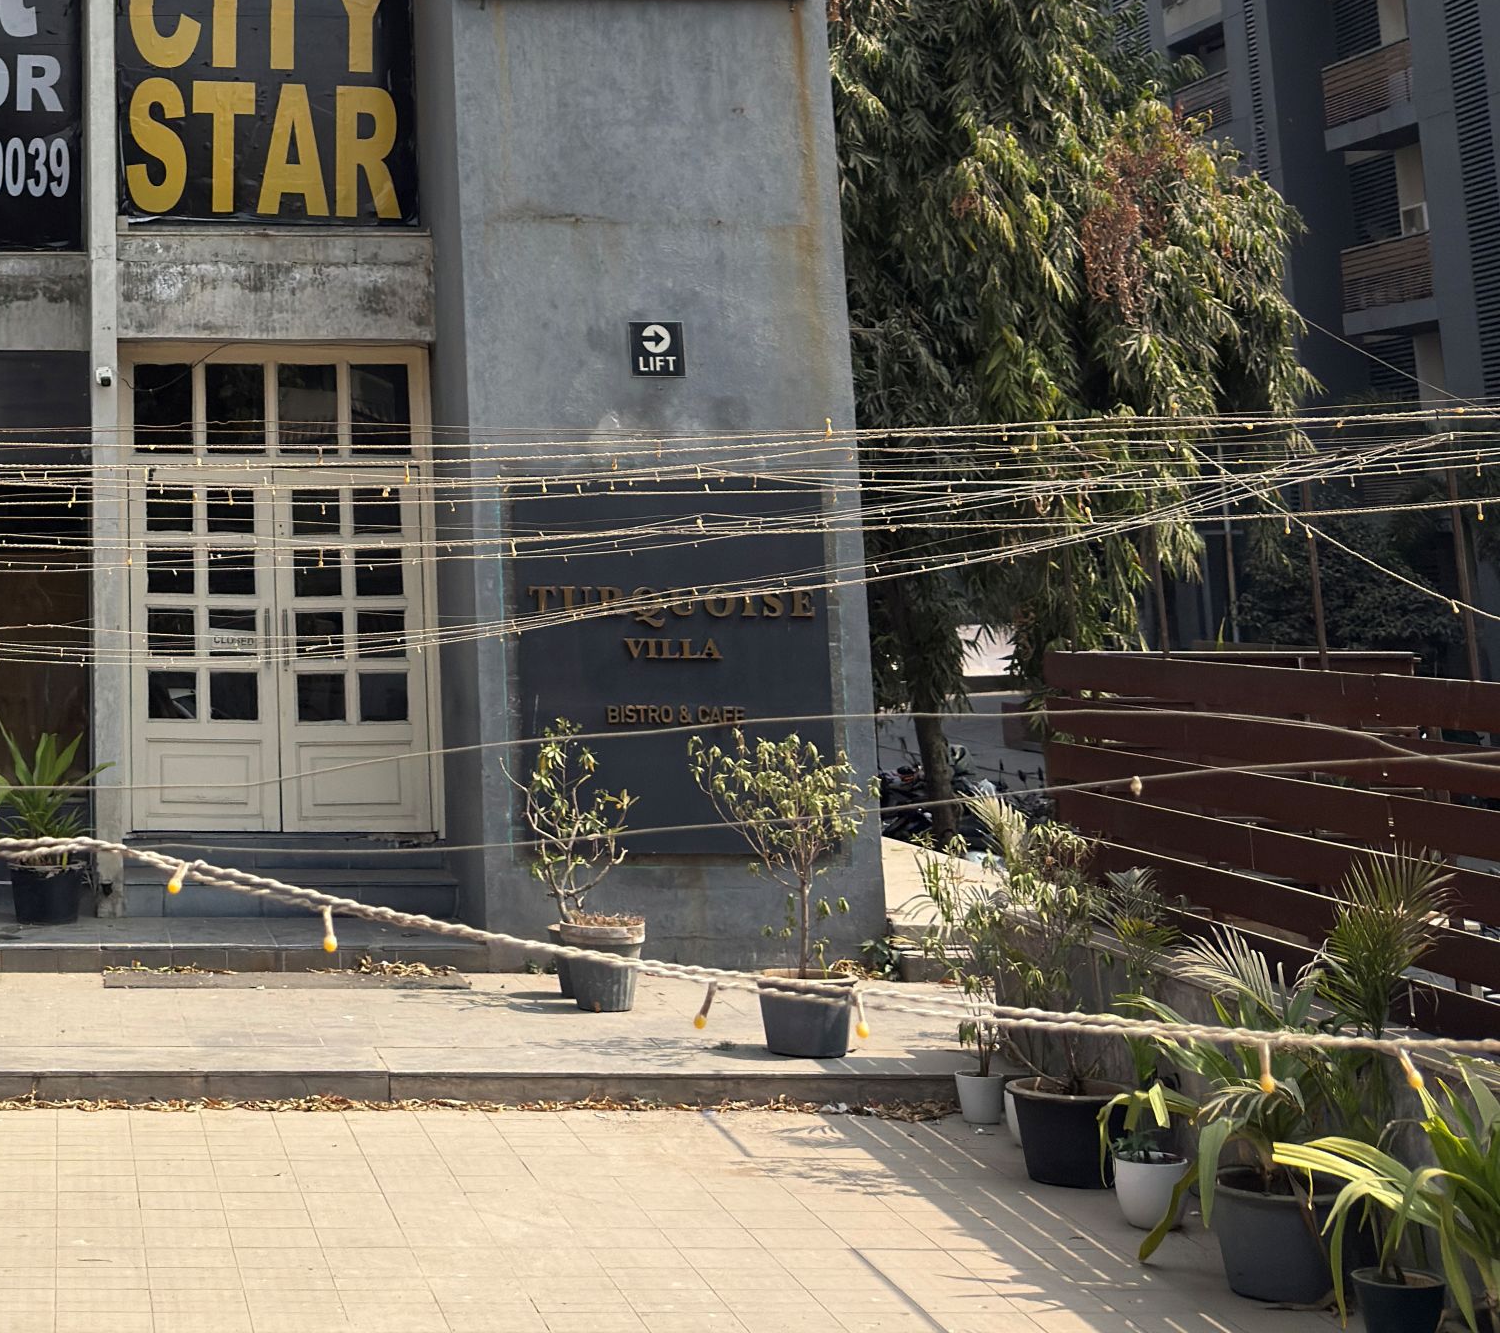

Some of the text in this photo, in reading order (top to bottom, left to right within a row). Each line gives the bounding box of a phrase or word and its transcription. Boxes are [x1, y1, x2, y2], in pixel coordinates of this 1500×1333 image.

[126, 77, 402, 219] STAR
[638, 356, 677, 371] LIFT
[528, 586, 816, 628] TURQUOISE
[623, 638, 723, 659] VILLA
[606, 705, 746, 724] BISTRO & CAFE
